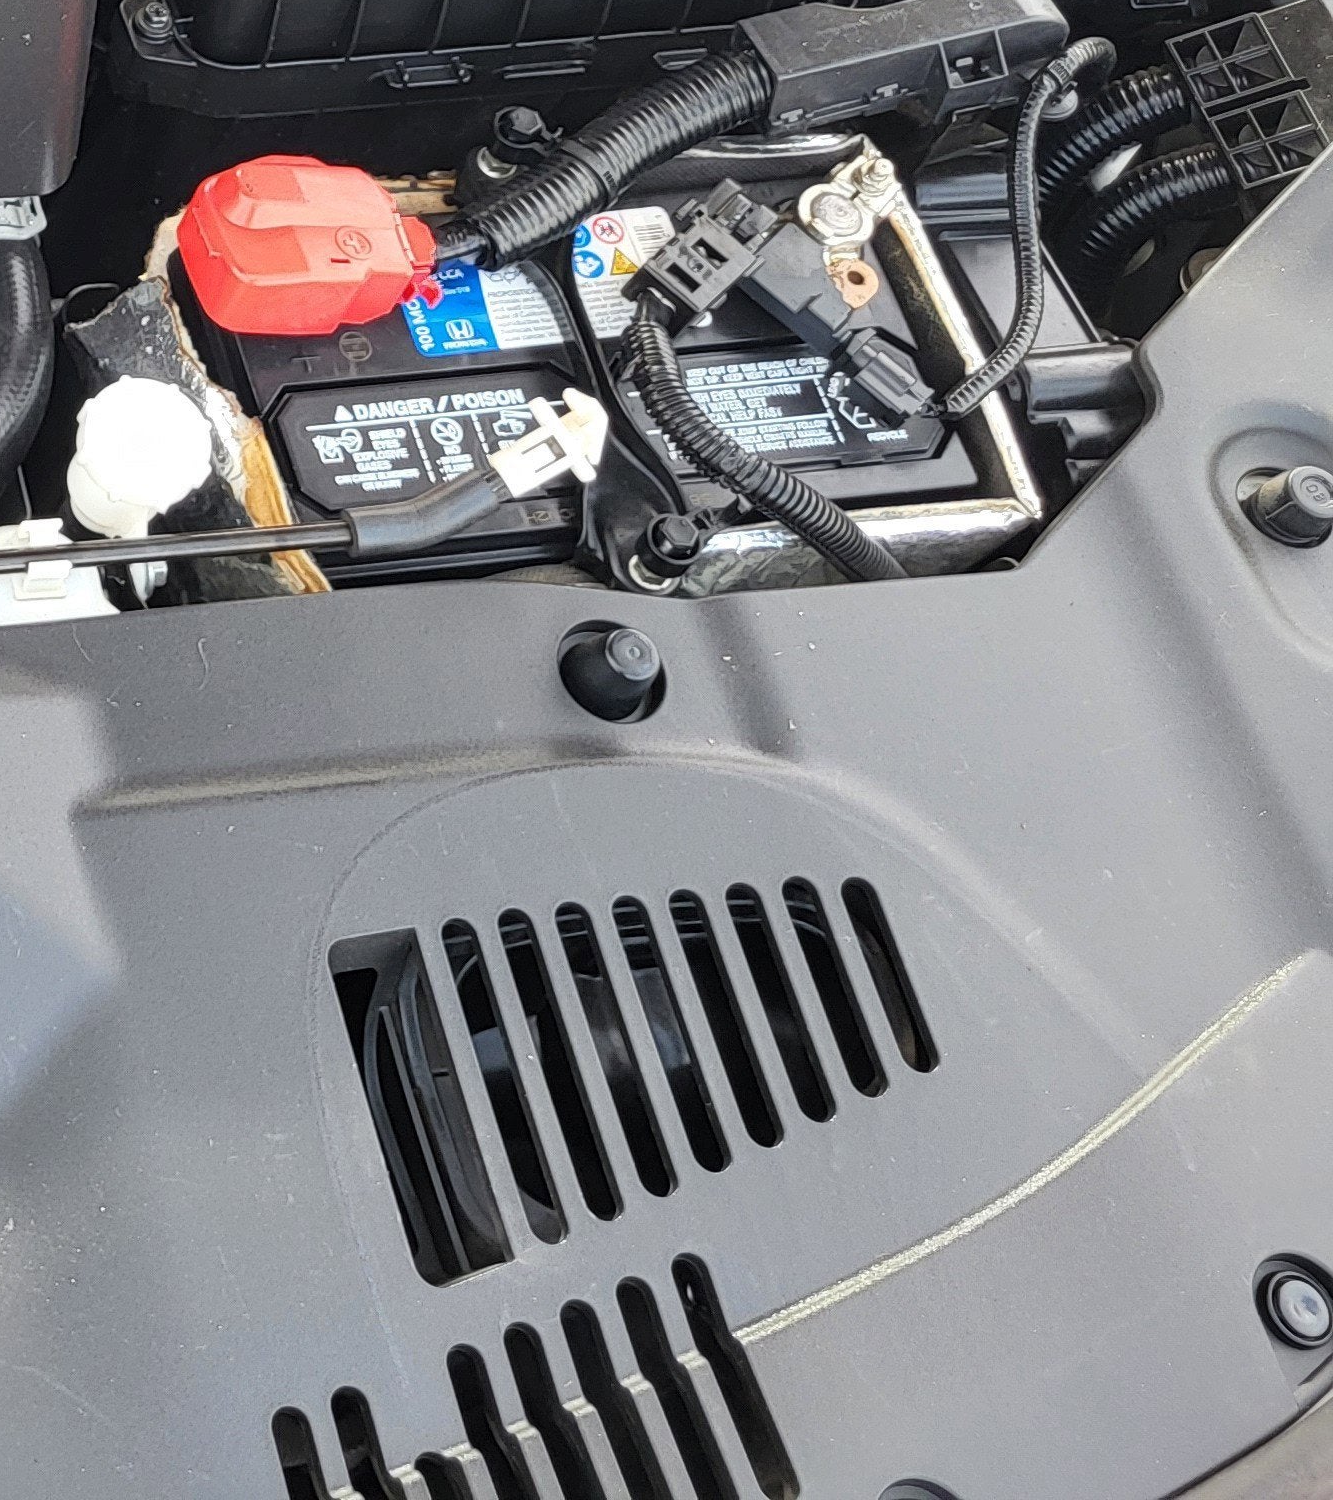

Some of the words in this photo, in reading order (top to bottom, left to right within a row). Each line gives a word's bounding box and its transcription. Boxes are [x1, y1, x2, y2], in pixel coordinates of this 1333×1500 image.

[406, 298, 427, 325] MC
[352, 397, 435, 421] DANGER
[449, 388, 527, 411] POISON
